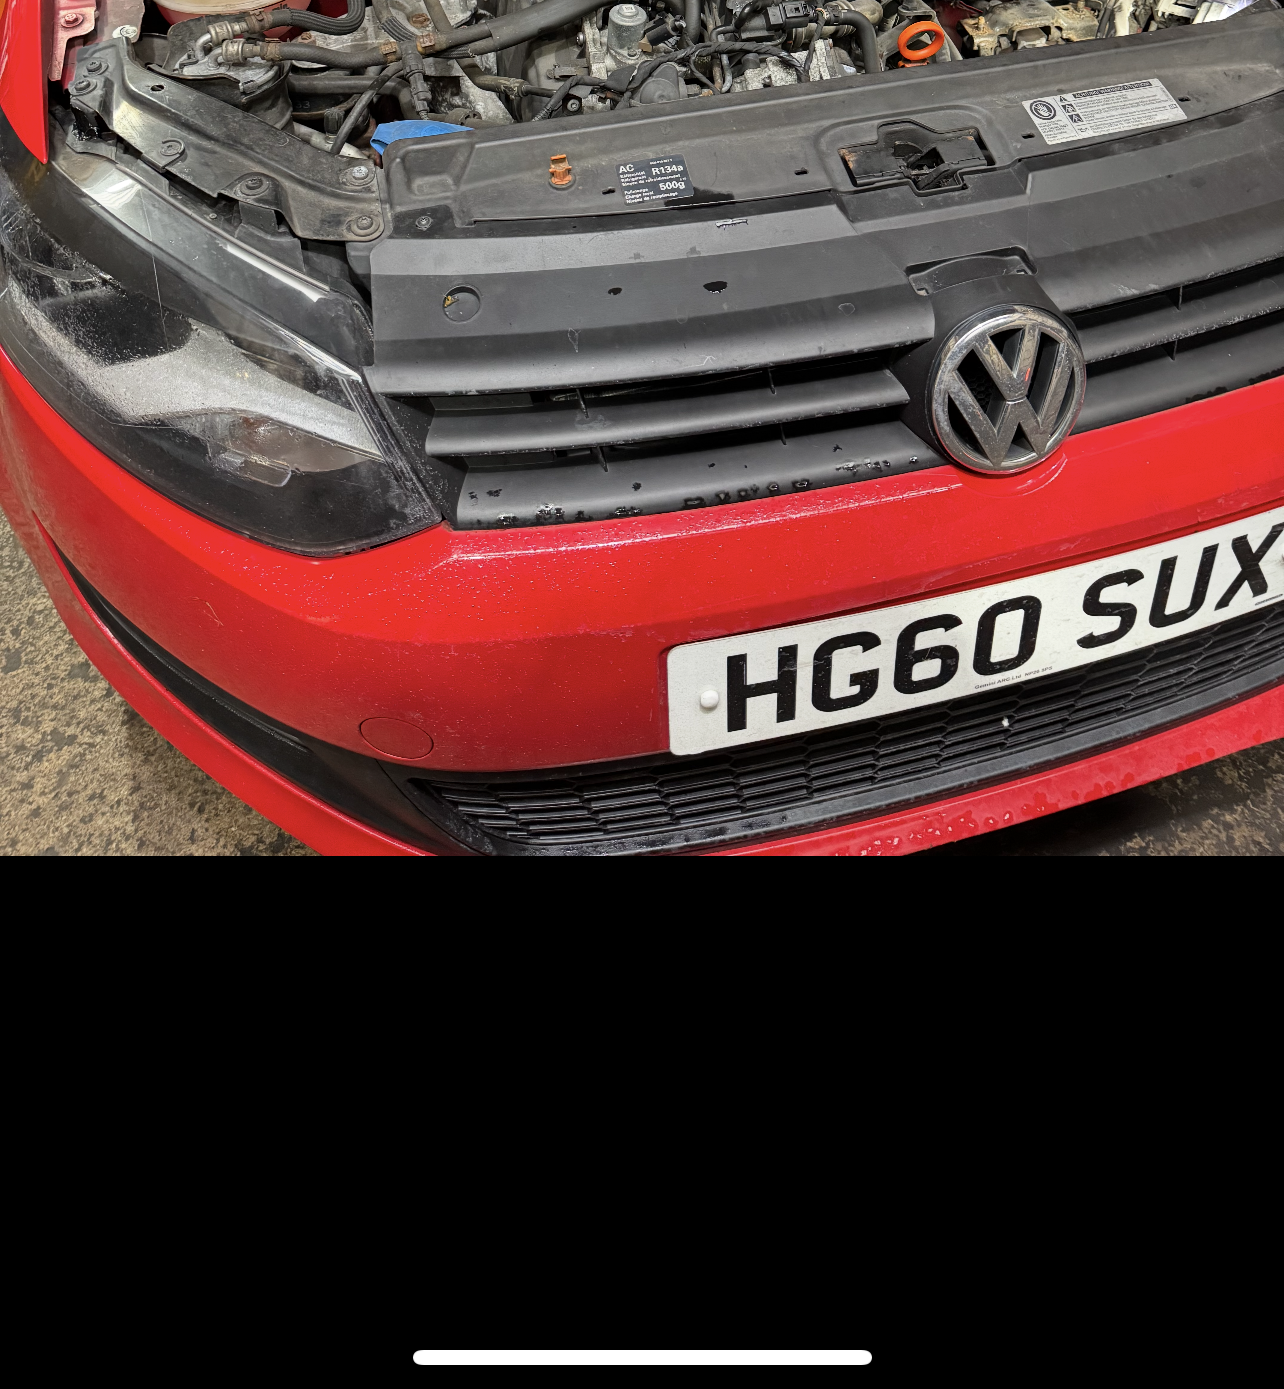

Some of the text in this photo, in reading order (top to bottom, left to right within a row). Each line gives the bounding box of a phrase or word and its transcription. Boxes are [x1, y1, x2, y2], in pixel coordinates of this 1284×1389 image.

[619, 164, 635, 174] AC
[651, 164, 684, 176] R134a
[659, 180, 685, 191] 500g
[726, 522, 1284, 733] HG60 SUX
[996, 677, 1011, 685] ARC
